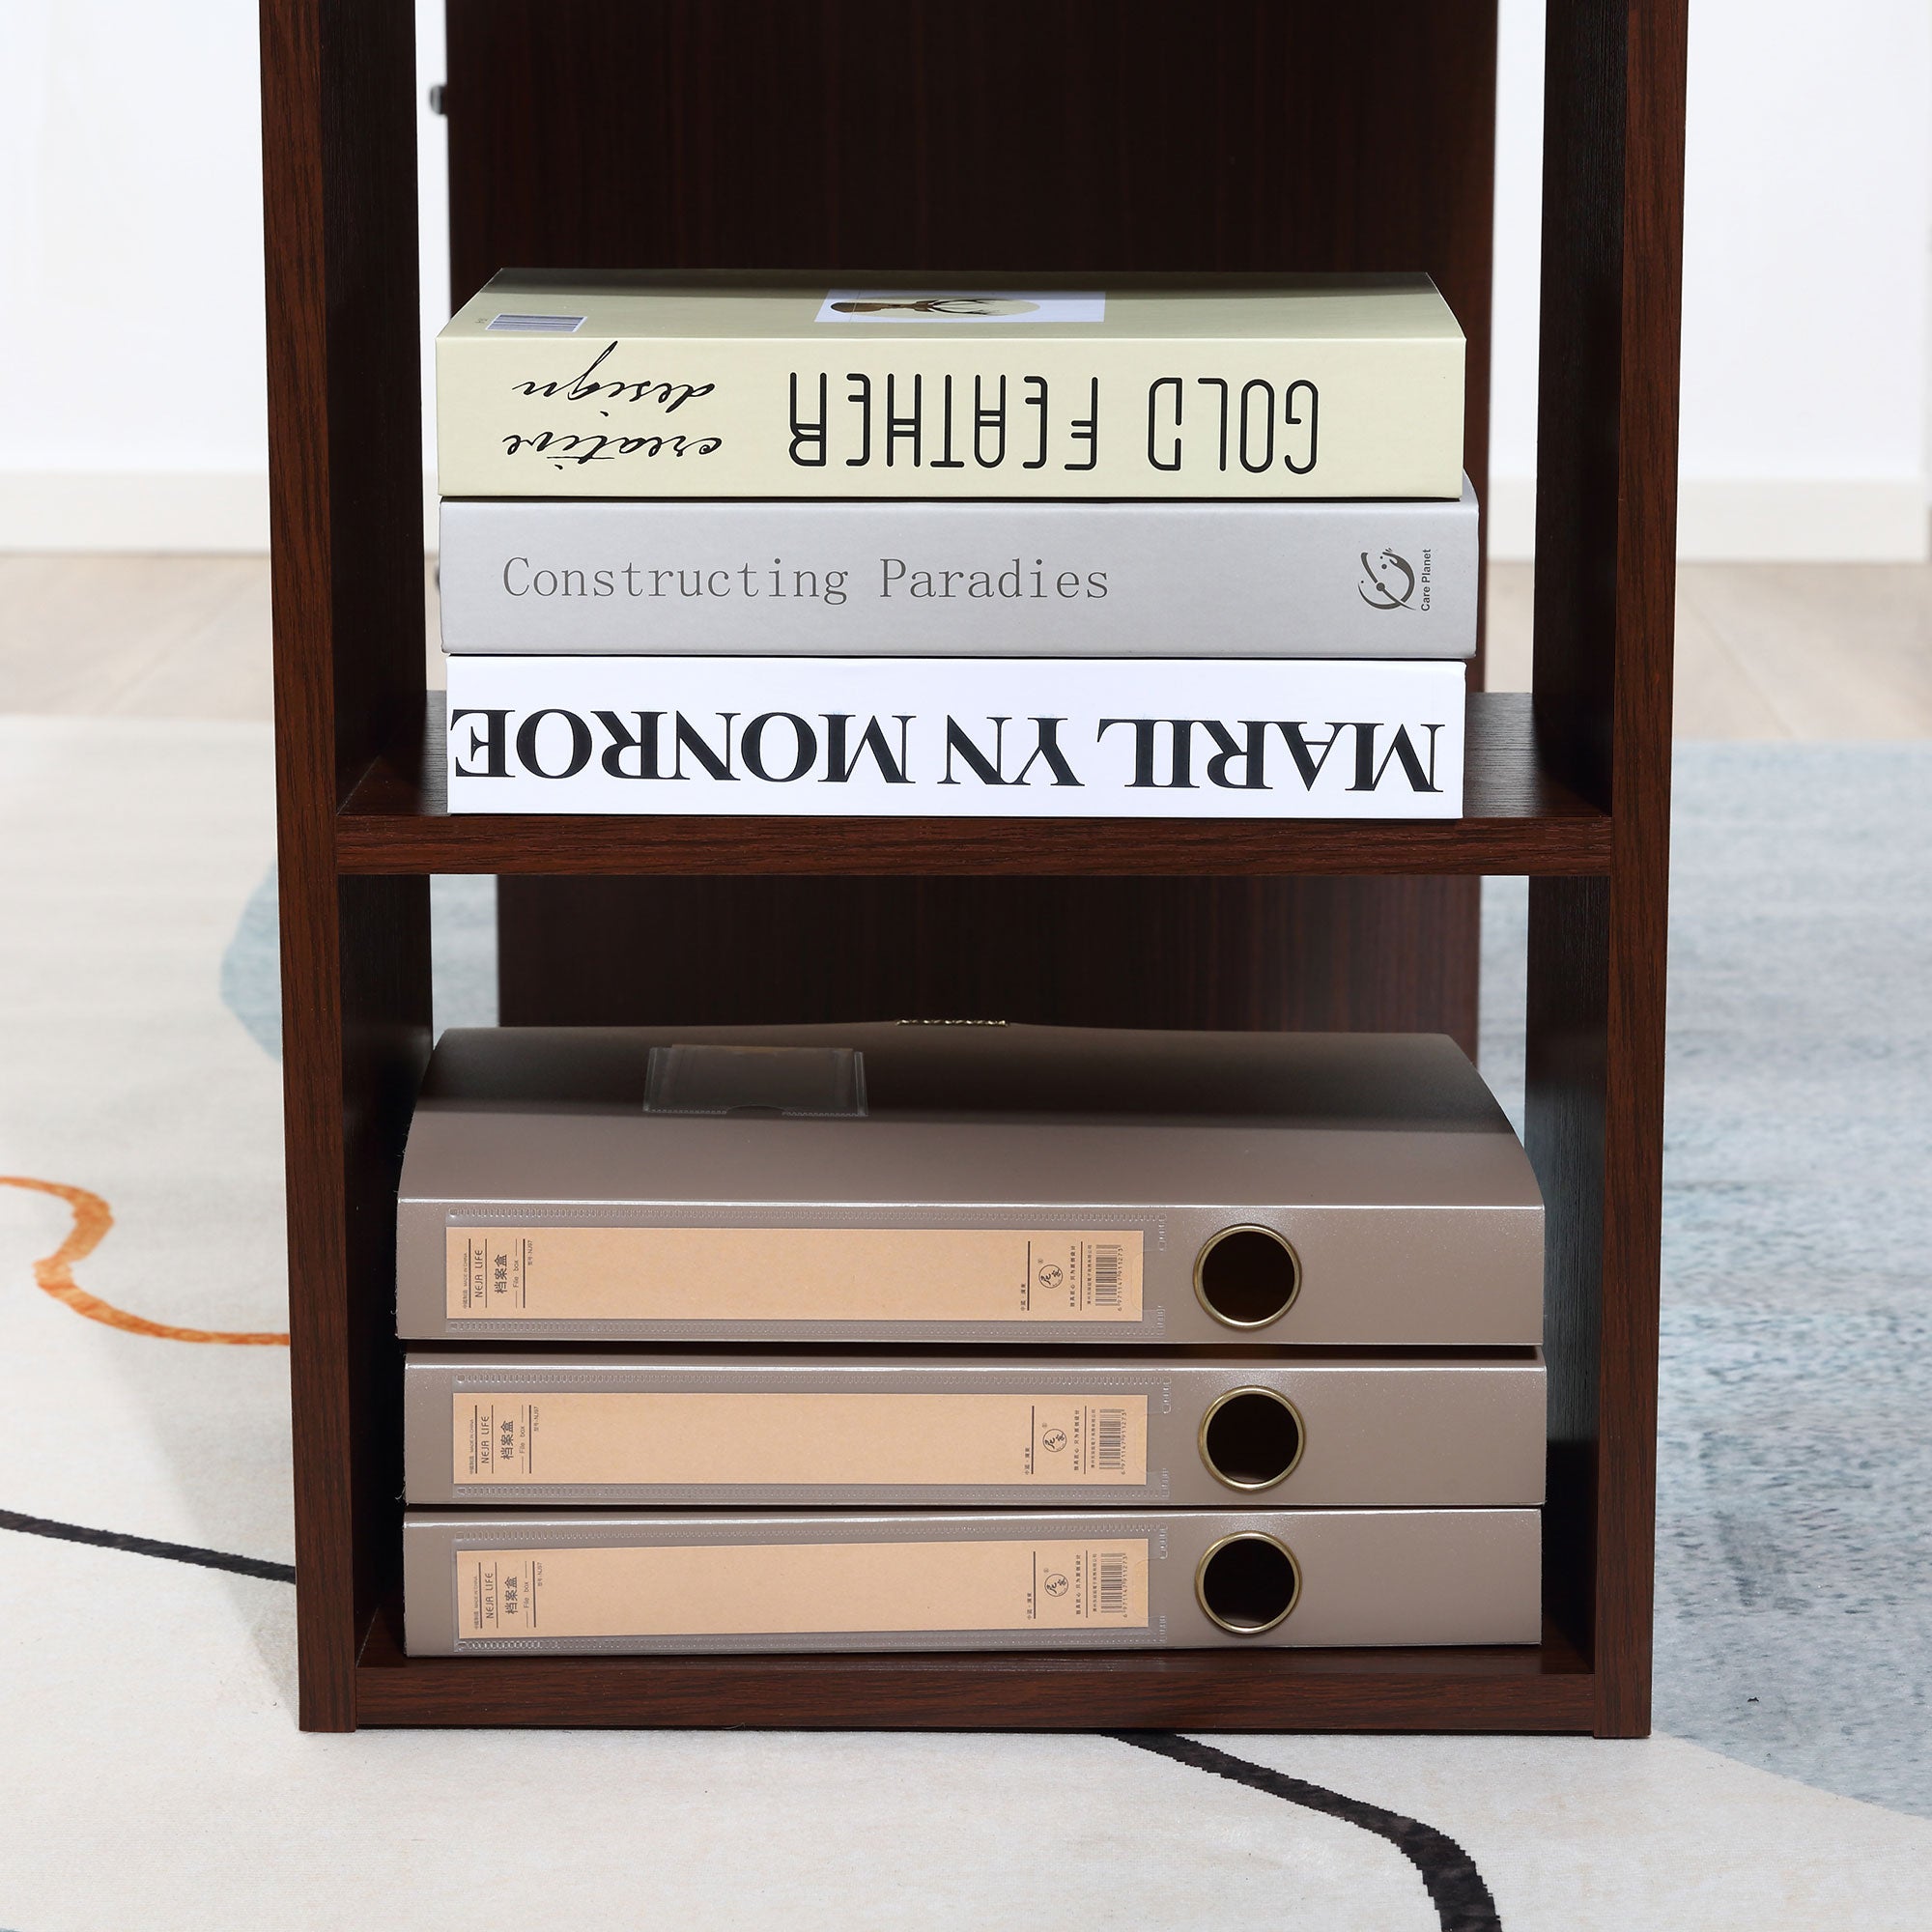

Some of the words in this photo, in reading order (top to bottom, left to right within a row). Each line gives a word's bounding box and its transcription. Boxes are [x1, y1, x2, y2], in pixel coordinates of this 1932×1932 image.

[512, 342, 715, 416] design
[789, 372, 1098, 470] FEATHER
[1148, 378, 1319, 474] GOLD
[502, 432, 722, 469] creative
[504, 557, 848, 605] Constructing
[880, 558, 1107, 598] Paradies
[1421, 549, 1432, 583] Planet
[1421, 586, 1431, 611] Care
[450, 709, 917, 783] MONROE
[474, 1250, 483, 1268] LIFE
[495, 1255, 507, 1293] 档案盒
[474, 1274, 483, 1297] NEJA
[500, 1420, 513, 1460] 档案盒
[505, 1577, 518, 1614] 档案盒
